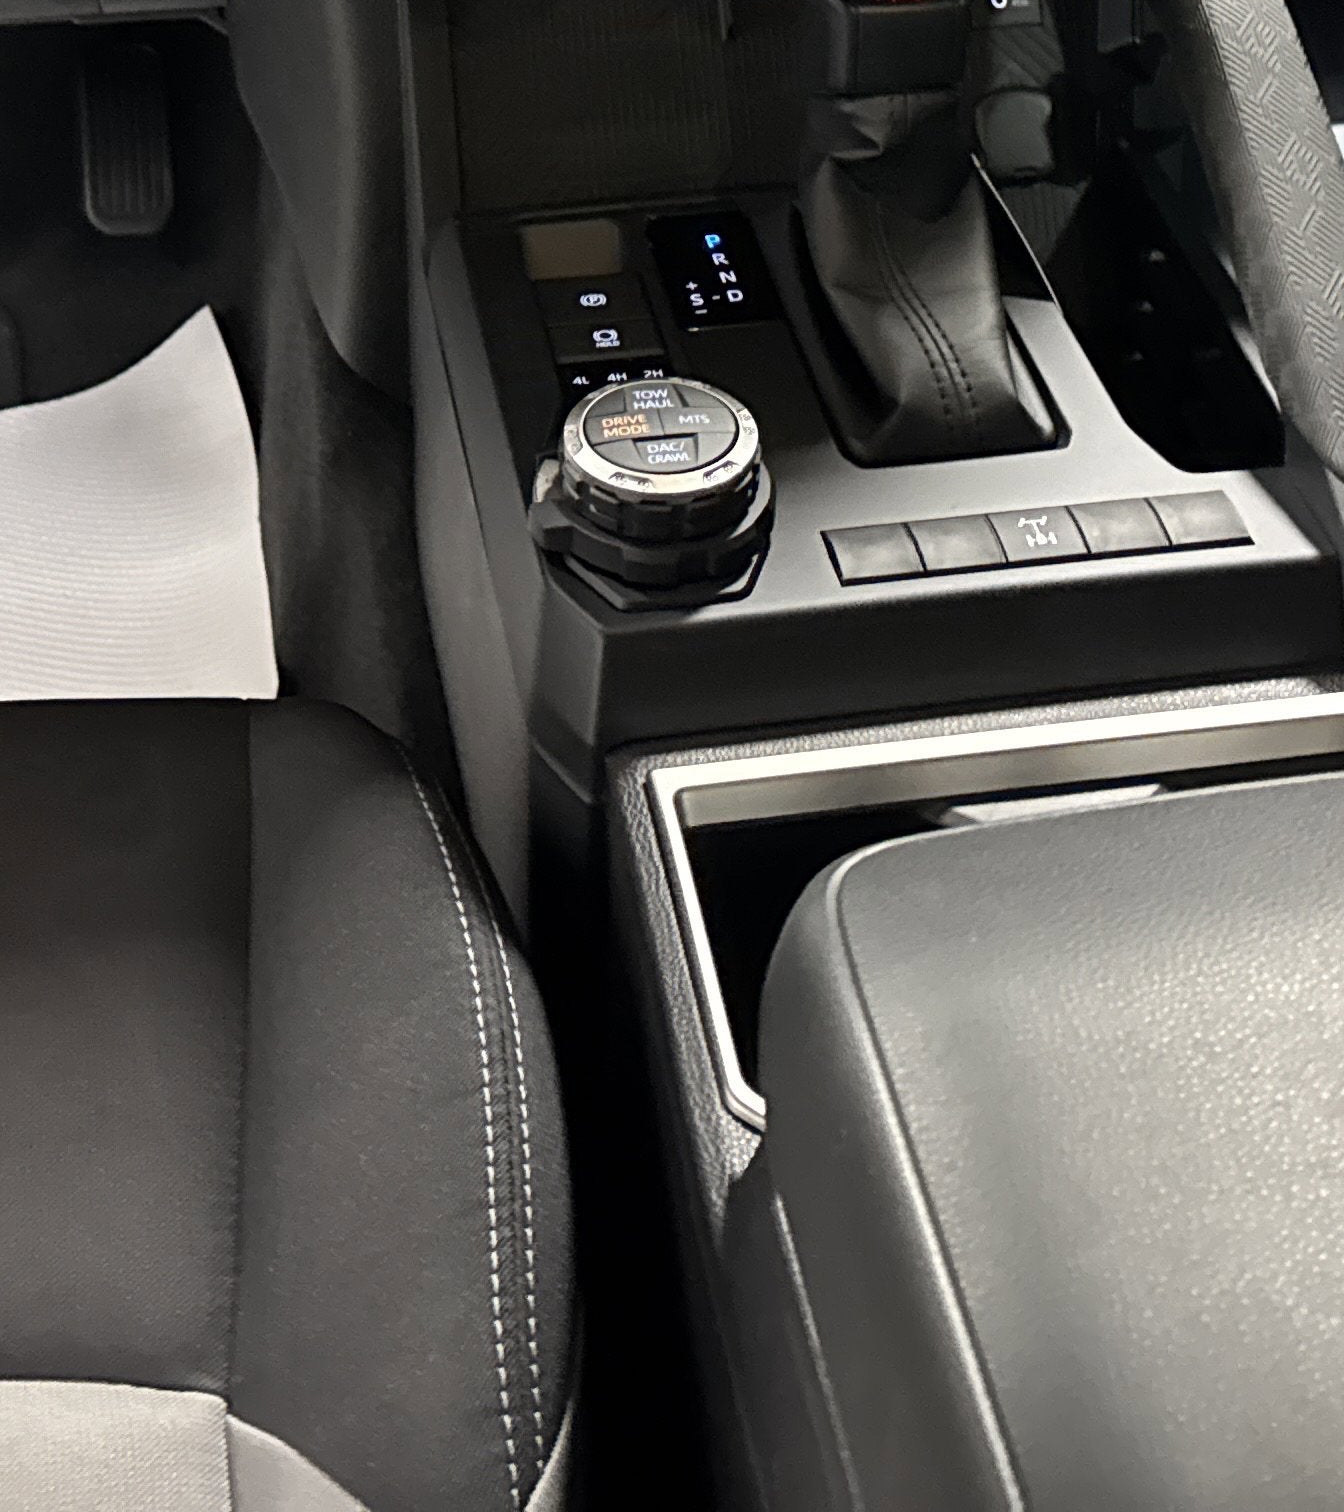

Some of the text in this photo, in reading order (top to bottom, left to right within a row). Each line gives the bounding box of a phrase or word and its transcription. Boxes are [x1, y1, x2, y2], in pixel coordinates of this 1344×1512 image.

[704, 234, 720, 249] P
[712, 253, 729, 266] R
[719, 271, 737, 284] N
[690, 290, 743, 306] S D
[572, 375, 590, 385] 4L
[607, 372, 628, 382] 4H
[632, 390, 669, 400] TOW
[633, 399, 675, 410] HAUL
[602, 413, 648, 428] DRIVE
[679, 415, 711, 425] MTS
[603, 424, 651, 438] MODE
[647, 441, 685, 454] DAC/
